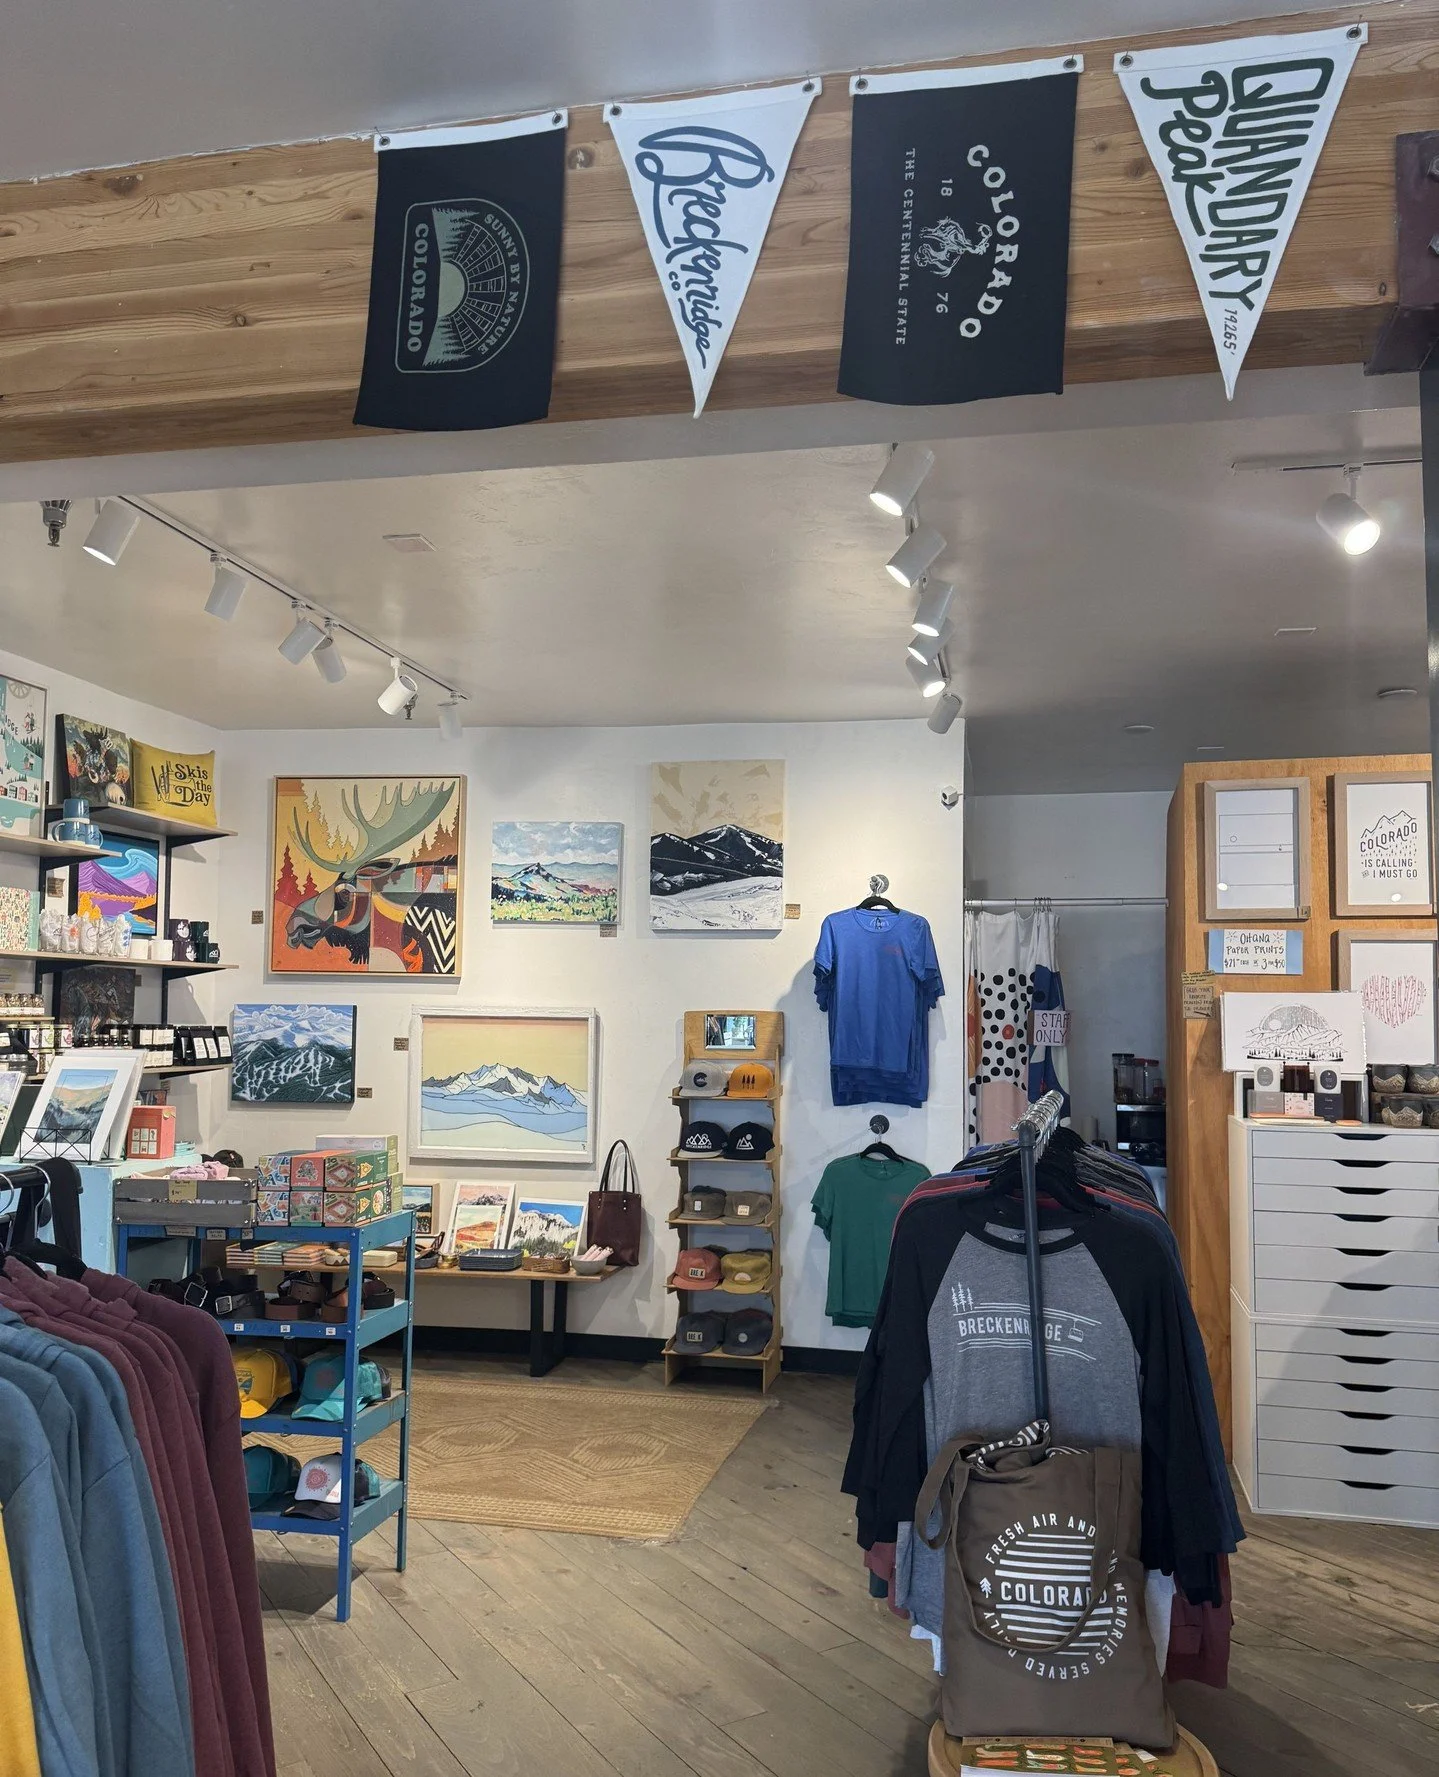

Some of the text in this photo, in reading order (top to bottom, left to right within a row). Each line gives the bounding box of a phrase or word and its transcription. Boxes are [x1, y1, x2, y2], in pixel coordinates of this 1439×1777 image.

[1140, 70, 1229, 237] Peak
[940, 178, 953, 197] 18
[1198, 57, 1334, 312] QUANDARY
[635, 125, 774, 370] Breckenridge
[895, 148, 916, 345] THE CENTENNIAL STATE
[959, 144, 1020, 338] COLORADO
[407, 222, 429, 352] COLORADO
[479, 212, 521, 355] SUNNY BY NATURE
[935, 292, 948, 314] 76
[174, 763, 208, 780] Skis
[174, 785, 211, 806] Day
[196, 780, 212, 792] the
[1360, 822, 1417, 853] COLORADO
[1365, 859, 1413, 867] IS CALLING
[1380, 870, 1403, 878] MUST
[1406, 869, 1418, 878] GO
[1036, 1029, 1067, 1044] ONLY
[958, 1317, 1063, 1342] BRECKENRGE
[985, 1513, 1096, 1564] FRESH AIR AND
[1095, 1582, 1128, 1665] MEMORIES
[1025, 1657, 1090, 1680] SERVED
